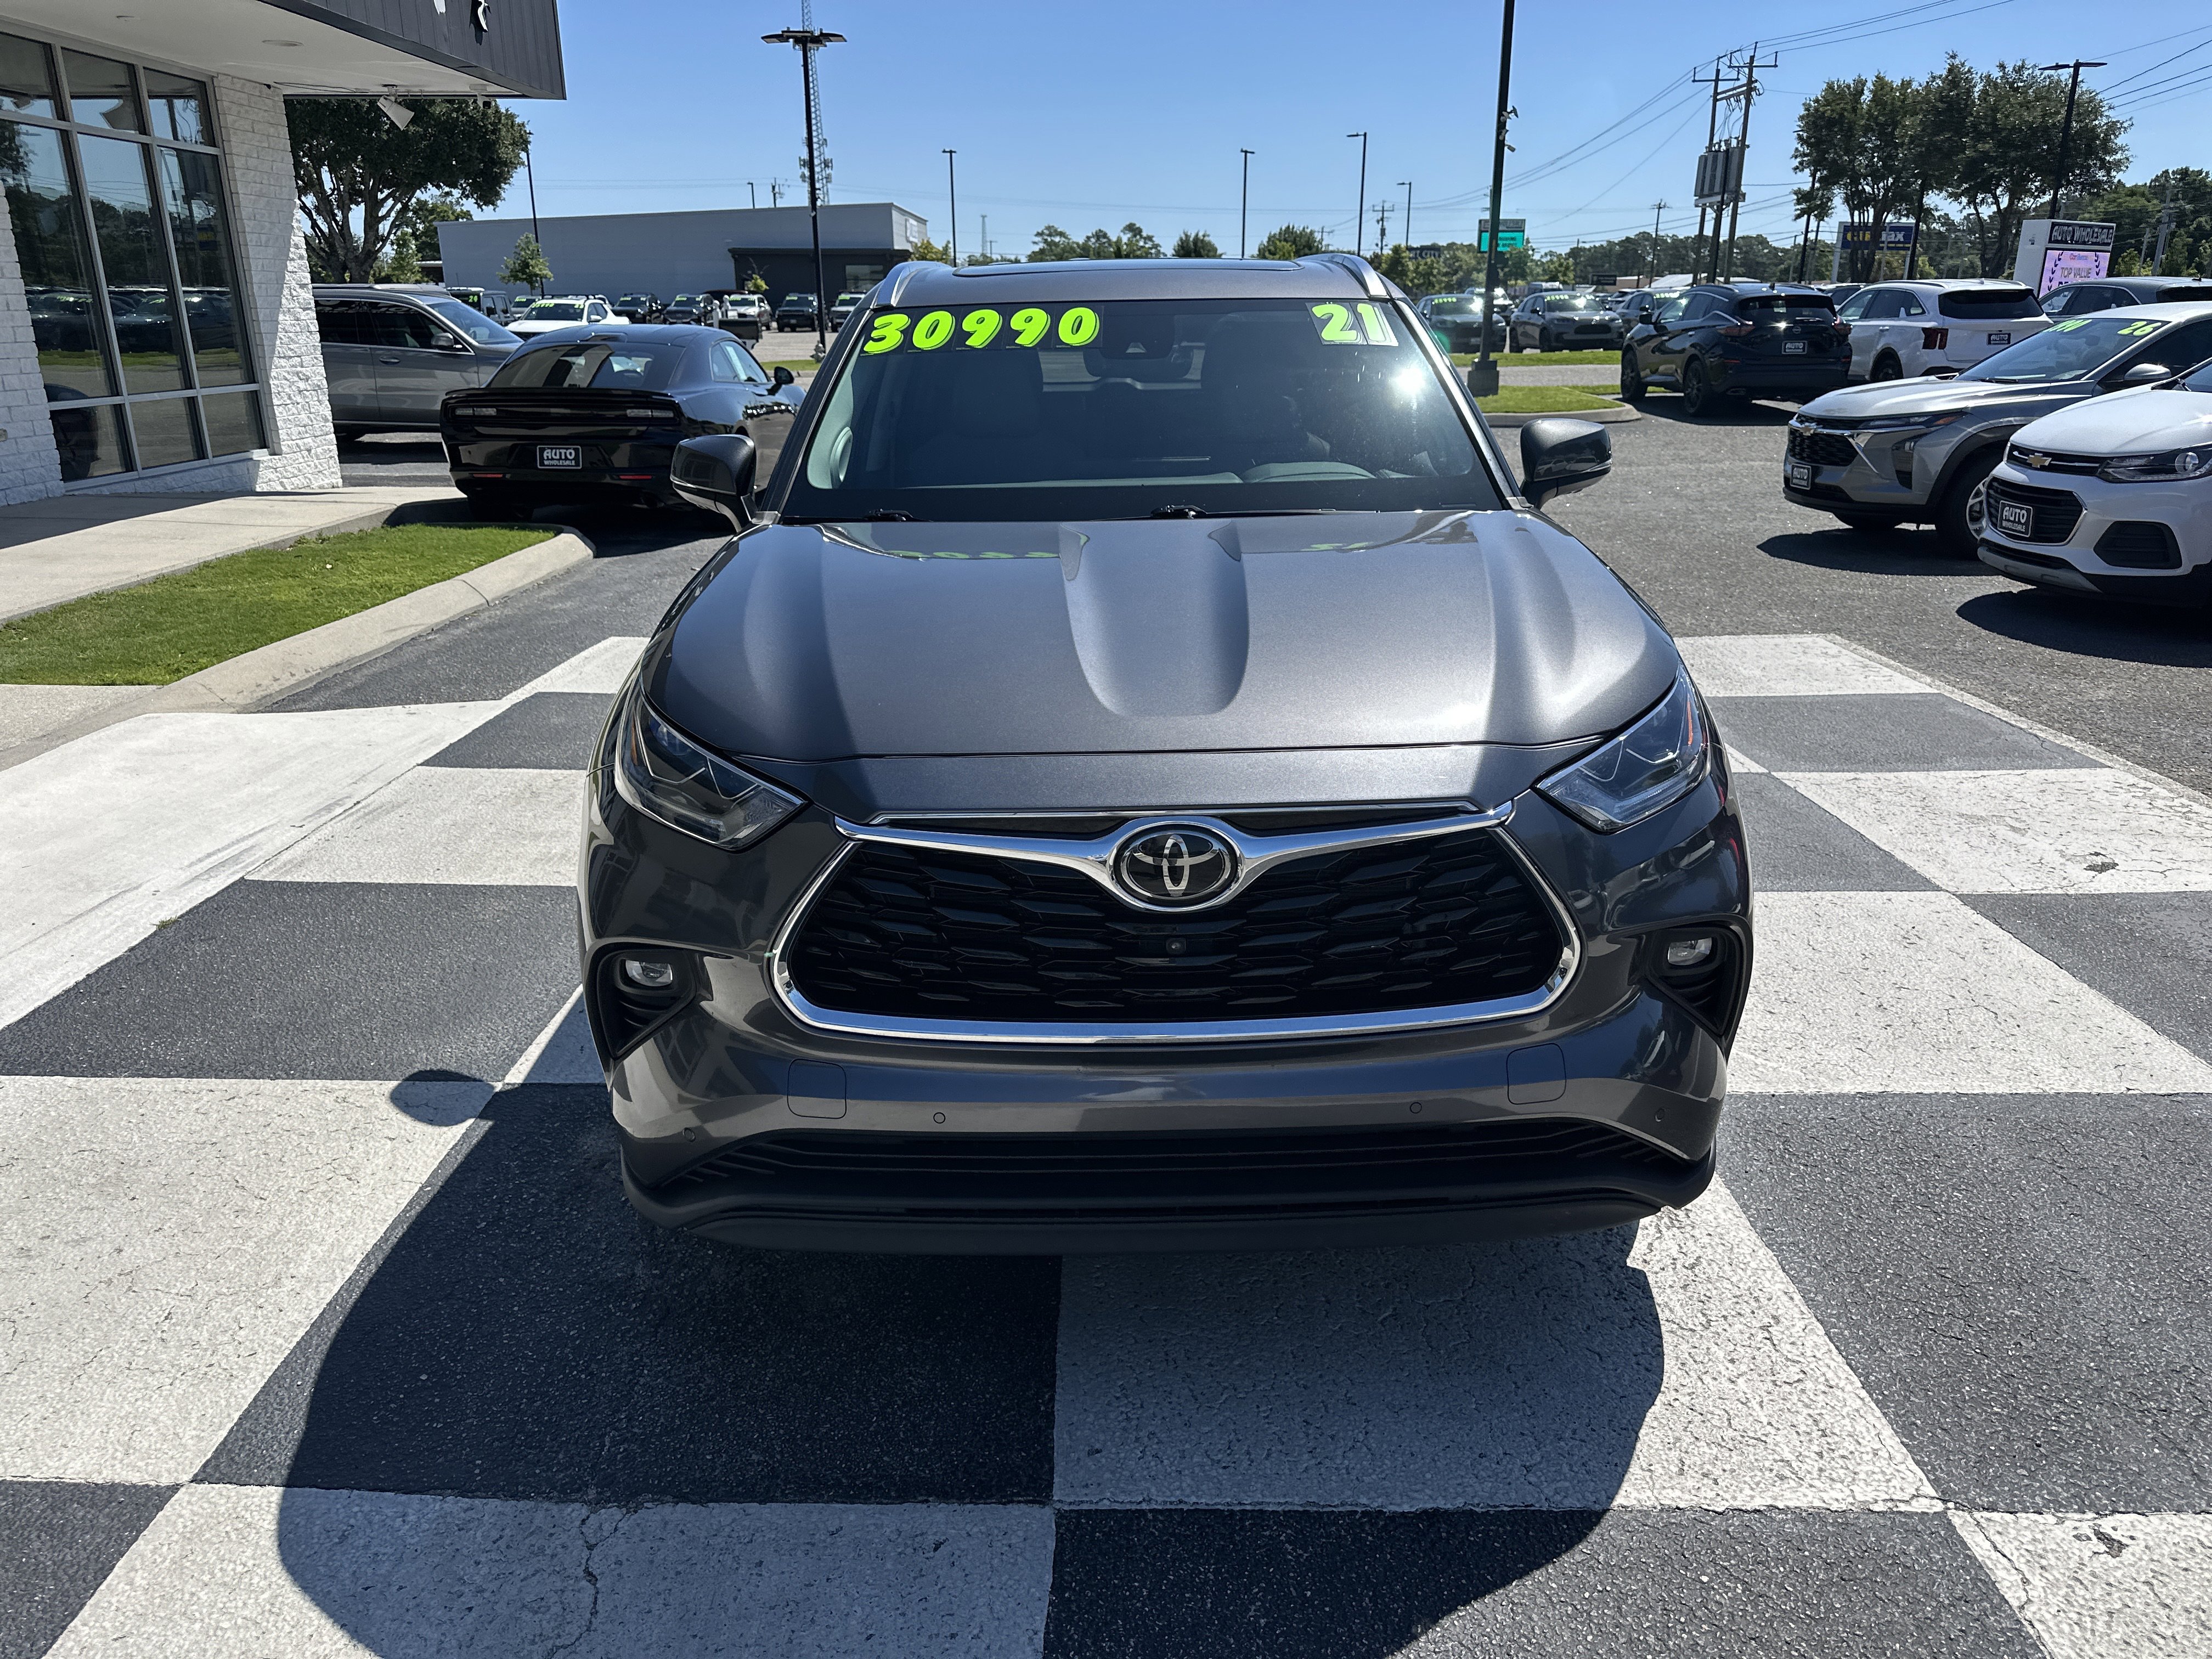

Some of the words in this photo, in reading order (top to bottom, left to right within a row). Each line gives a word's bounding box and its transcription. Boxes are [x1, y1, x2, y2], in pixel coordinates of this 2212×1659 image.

[2052, 225, 2073, 241] AUTO
[2074, 227, 2113, 243] WHOLESALE
[2061, 267, 2073, 278] TOP
[2074, 267, 2092, 279] VALUE
[863, 307, 1101, 354] 30990
[1312, 303, 1392, 343] 21
[2117, 320, 2162, 336] 26
[543, 449, 575, 459] AUTO
[2003, 506, 2027, 523] AUTO
